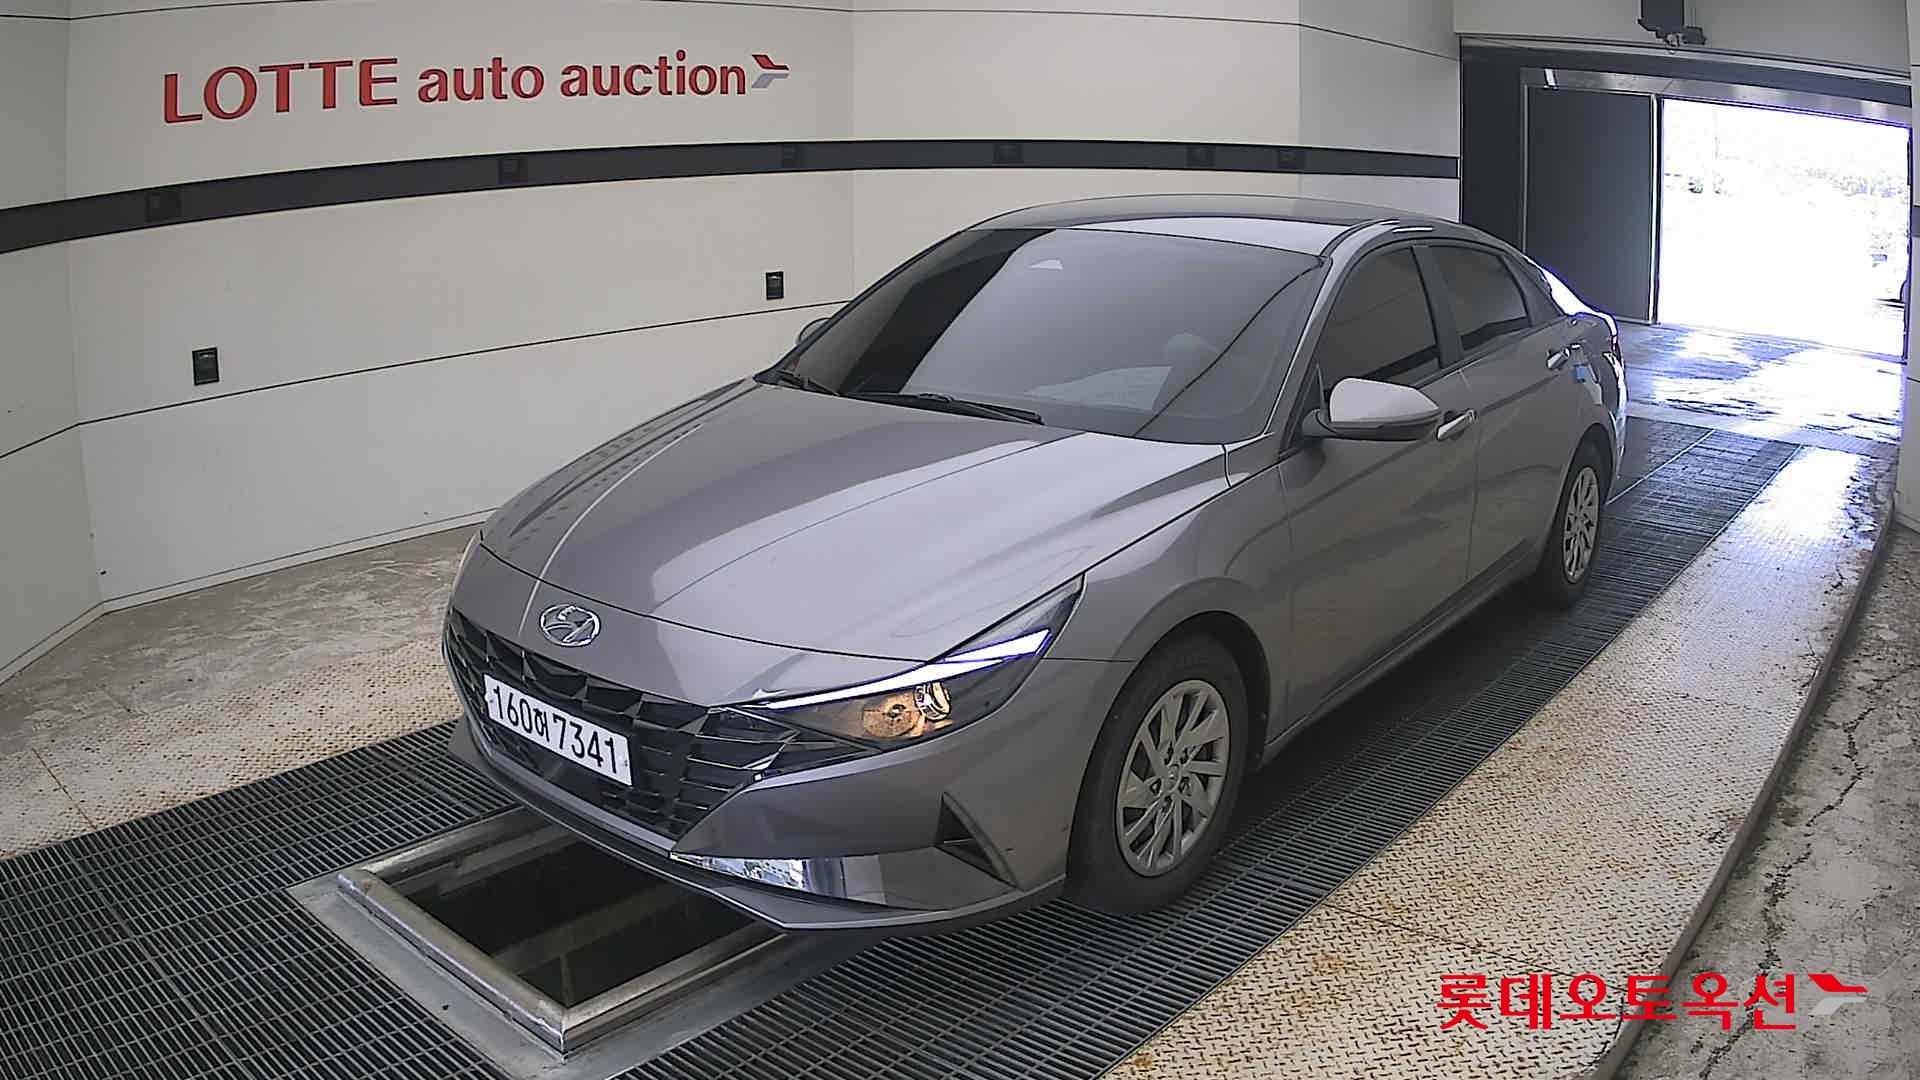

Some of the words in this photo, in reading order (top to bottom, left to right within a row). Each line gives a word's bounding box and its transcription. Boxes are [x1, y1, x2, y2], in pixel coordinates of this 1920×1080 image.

[164, 58, 398, 123] LOTTE
[418, 57, 545, 103] auto
[560, 50, 747, 97] auction
